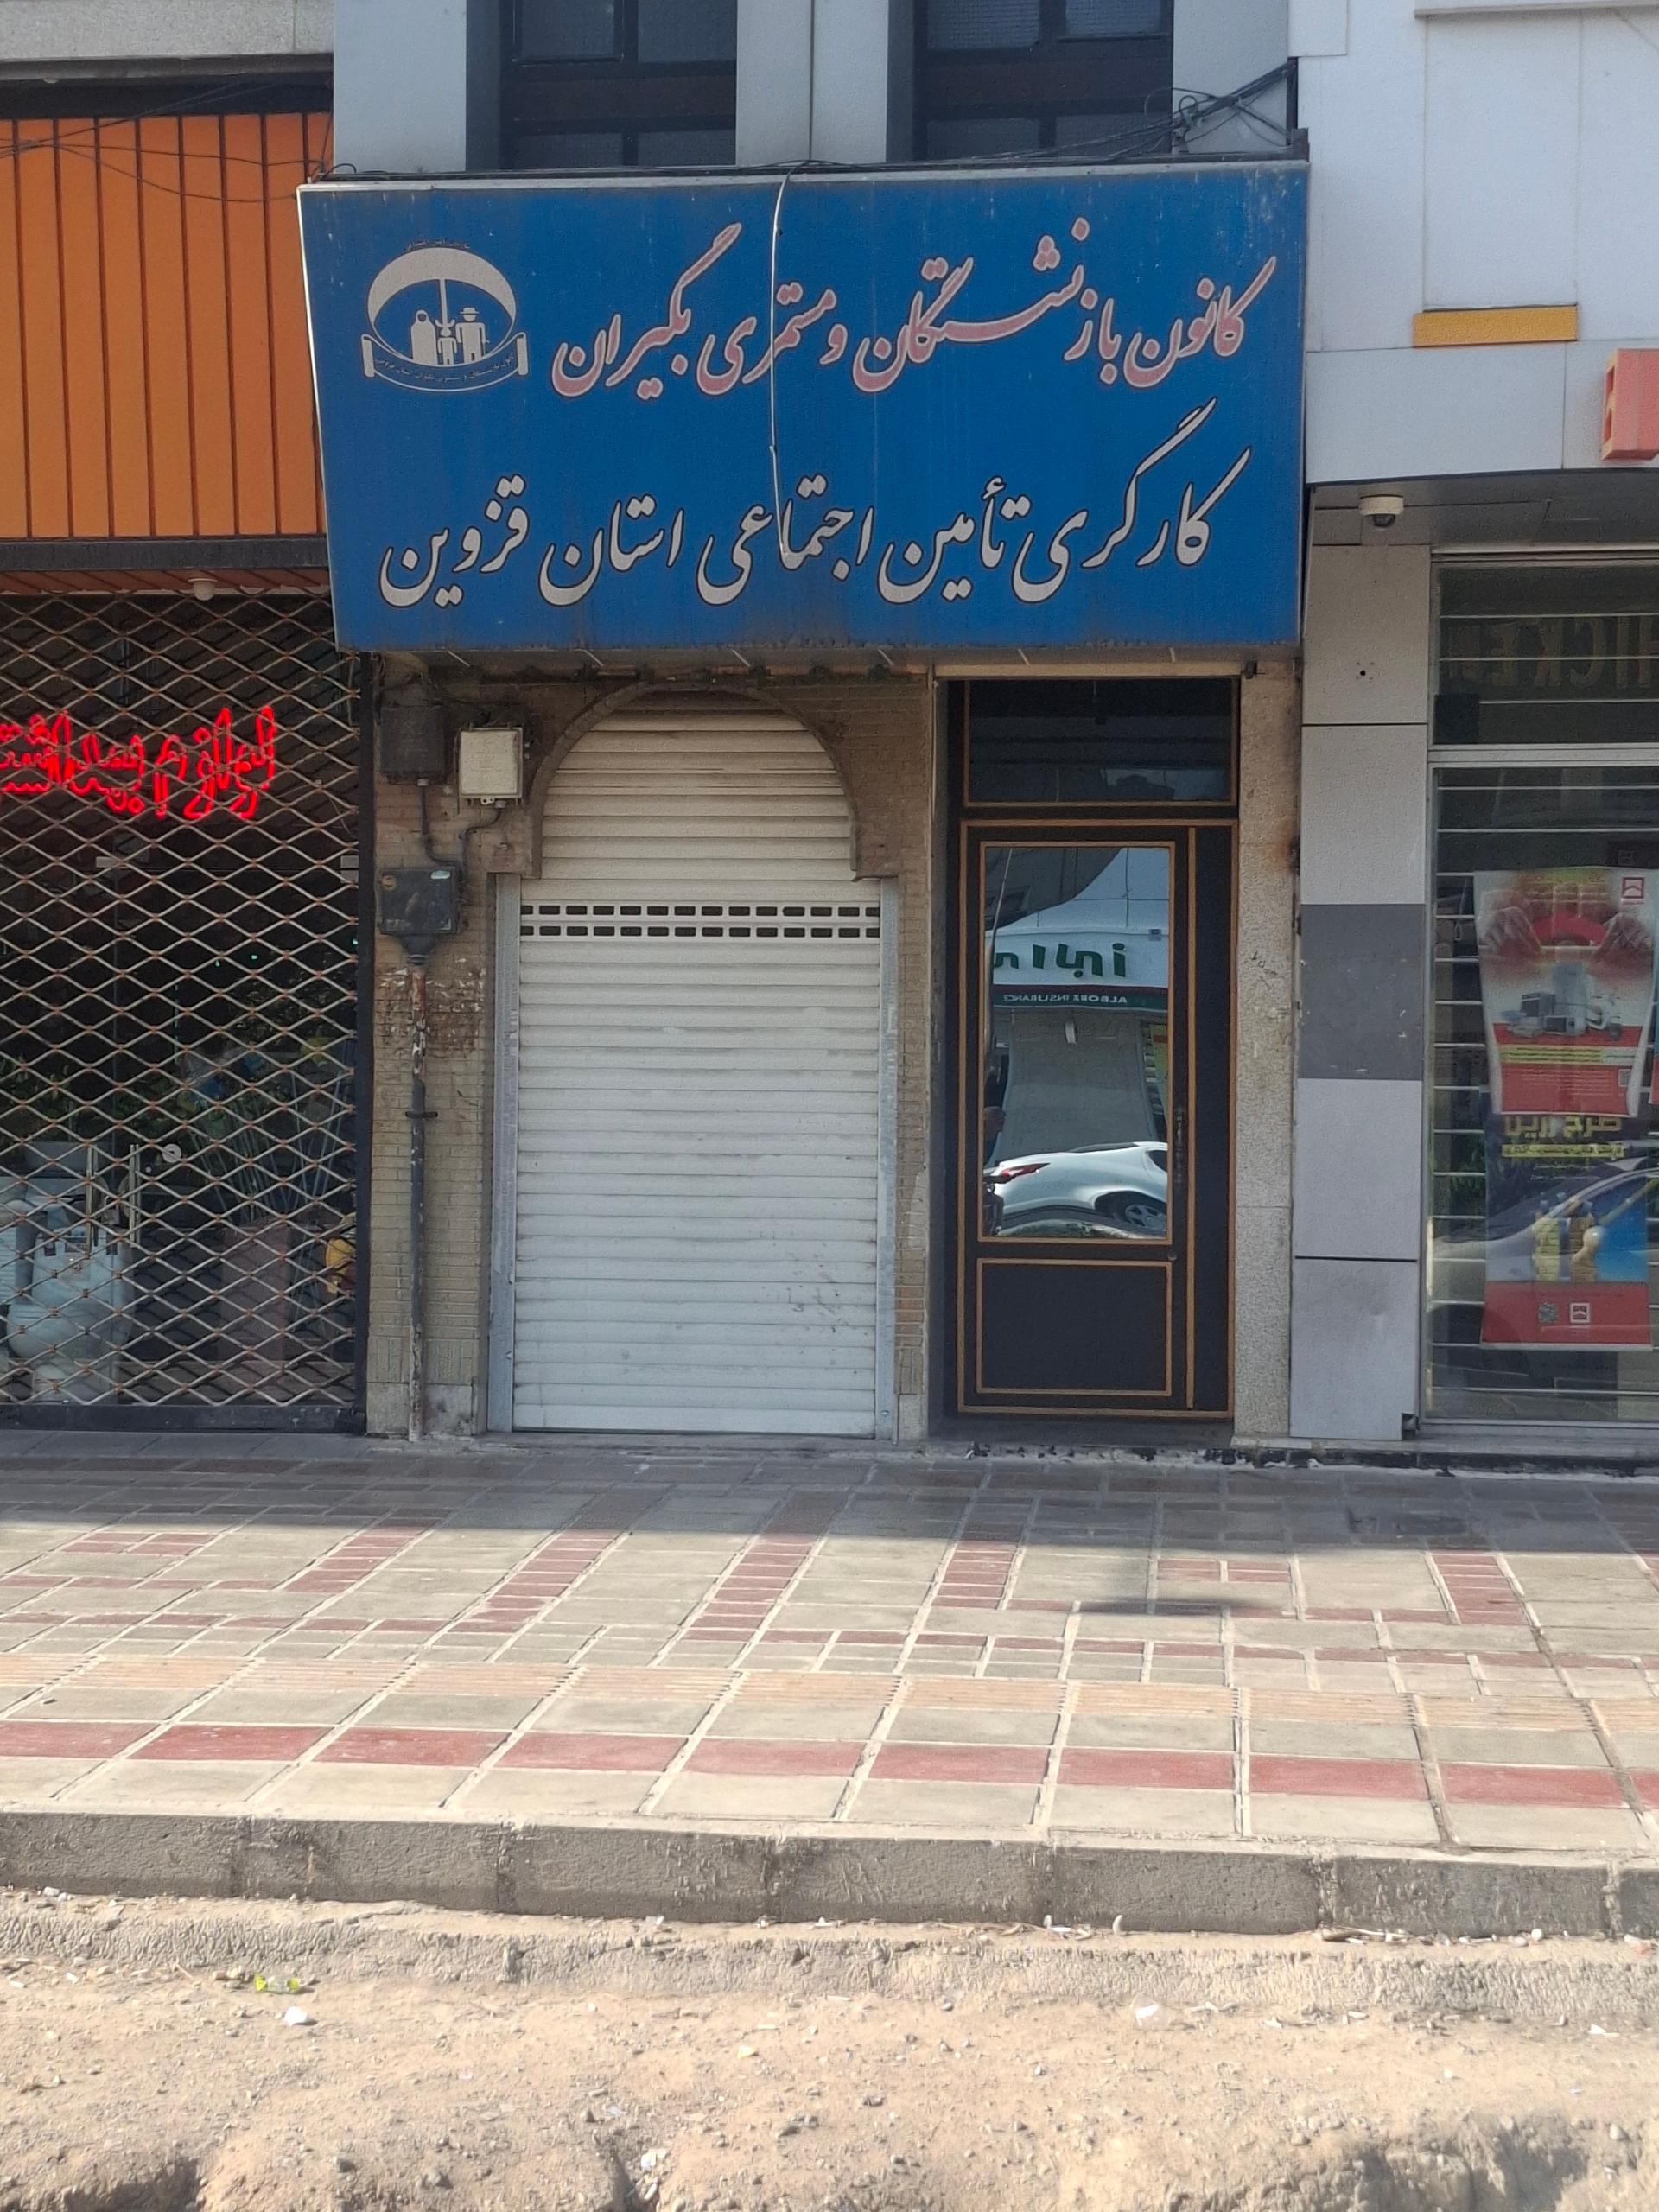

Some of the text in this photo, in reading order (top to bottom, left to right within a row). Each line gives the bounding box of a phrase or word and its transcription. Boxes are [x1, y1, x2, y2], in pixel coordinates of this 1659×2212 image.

[551, 217, 1276, 397] کانون بازنشستگان و مستمری بگیران
[378, 397, 1250, 607] کارگری تأمین اجتماعی استان قزوین
